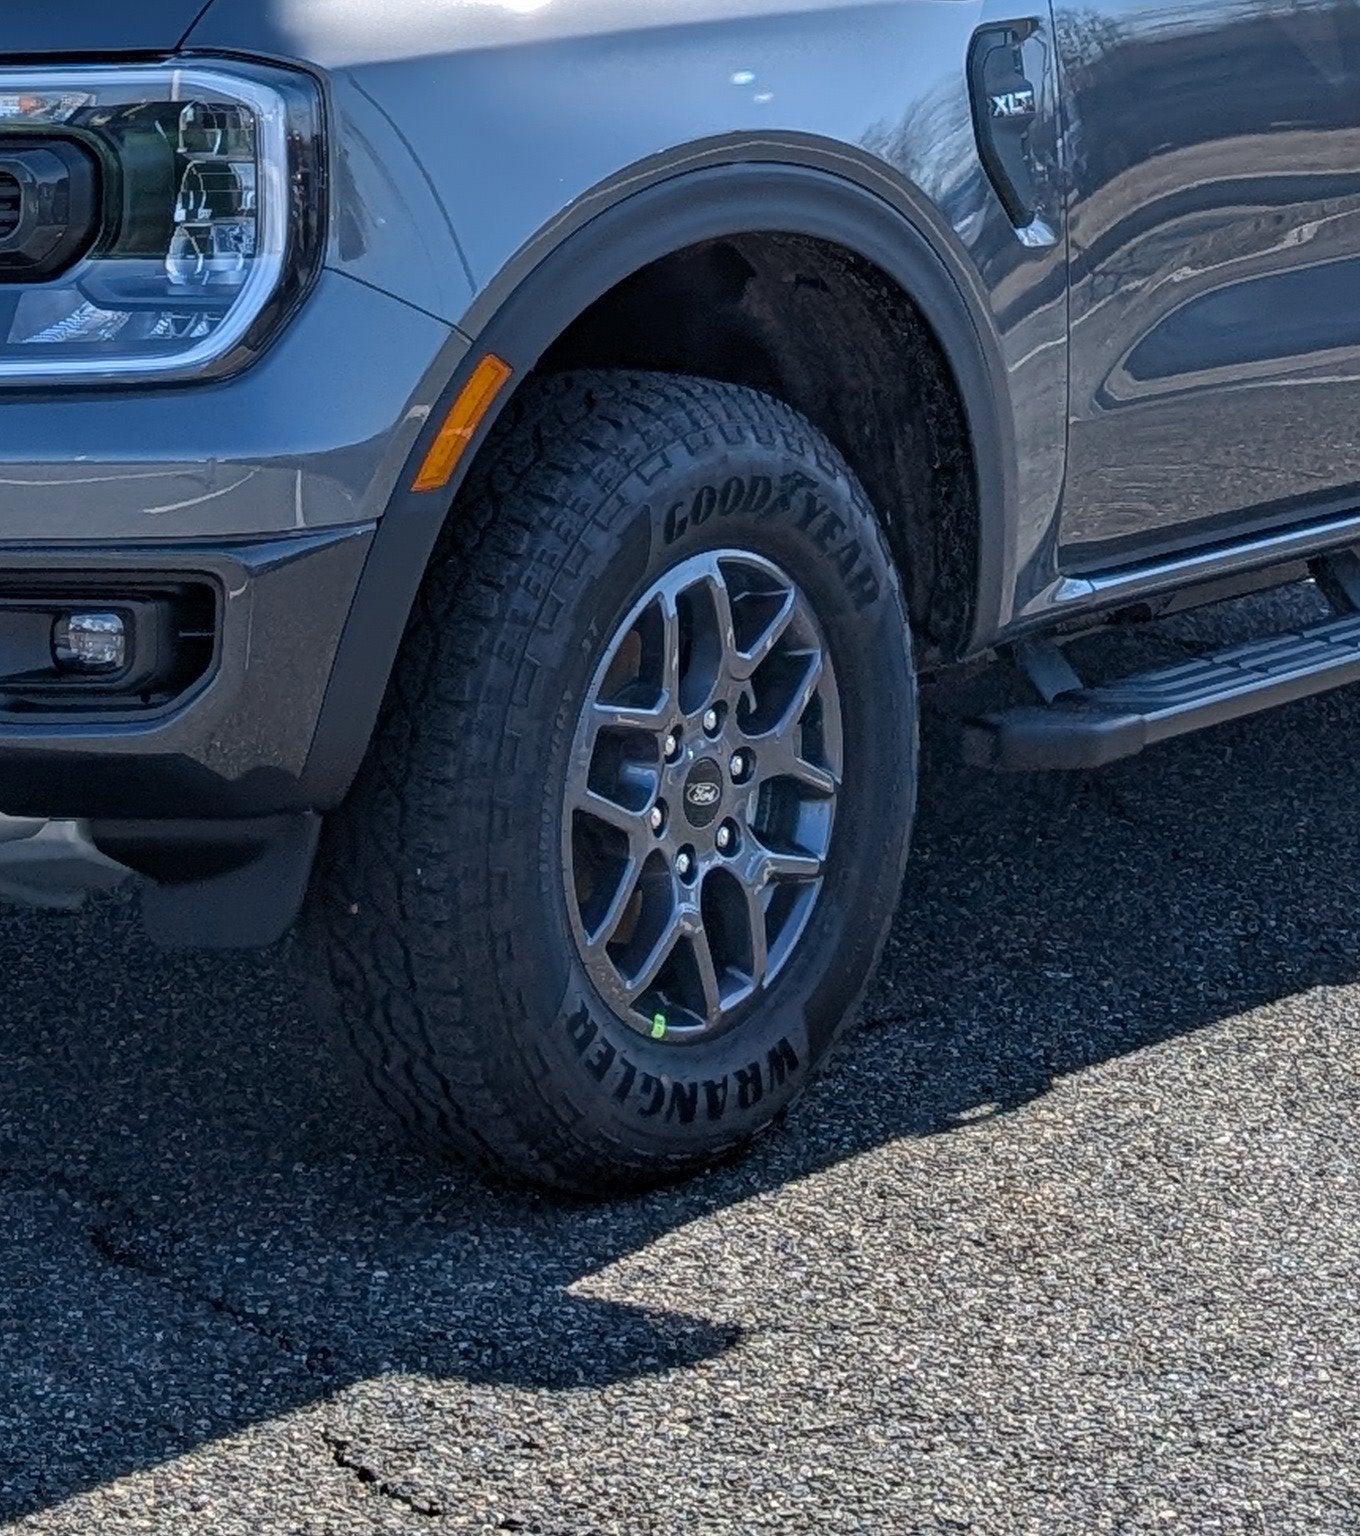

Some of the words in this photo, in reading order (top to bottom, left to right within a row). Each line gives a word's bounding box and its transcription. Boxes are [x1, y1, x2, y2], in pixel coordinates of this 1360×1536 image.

[993, 91, 1033, 115] XLT
[664, 471, 880, 610] GOODYEAR
[693, 785, 716, 801] Ford
[566, 999, 799, 1125] WRANGLER
